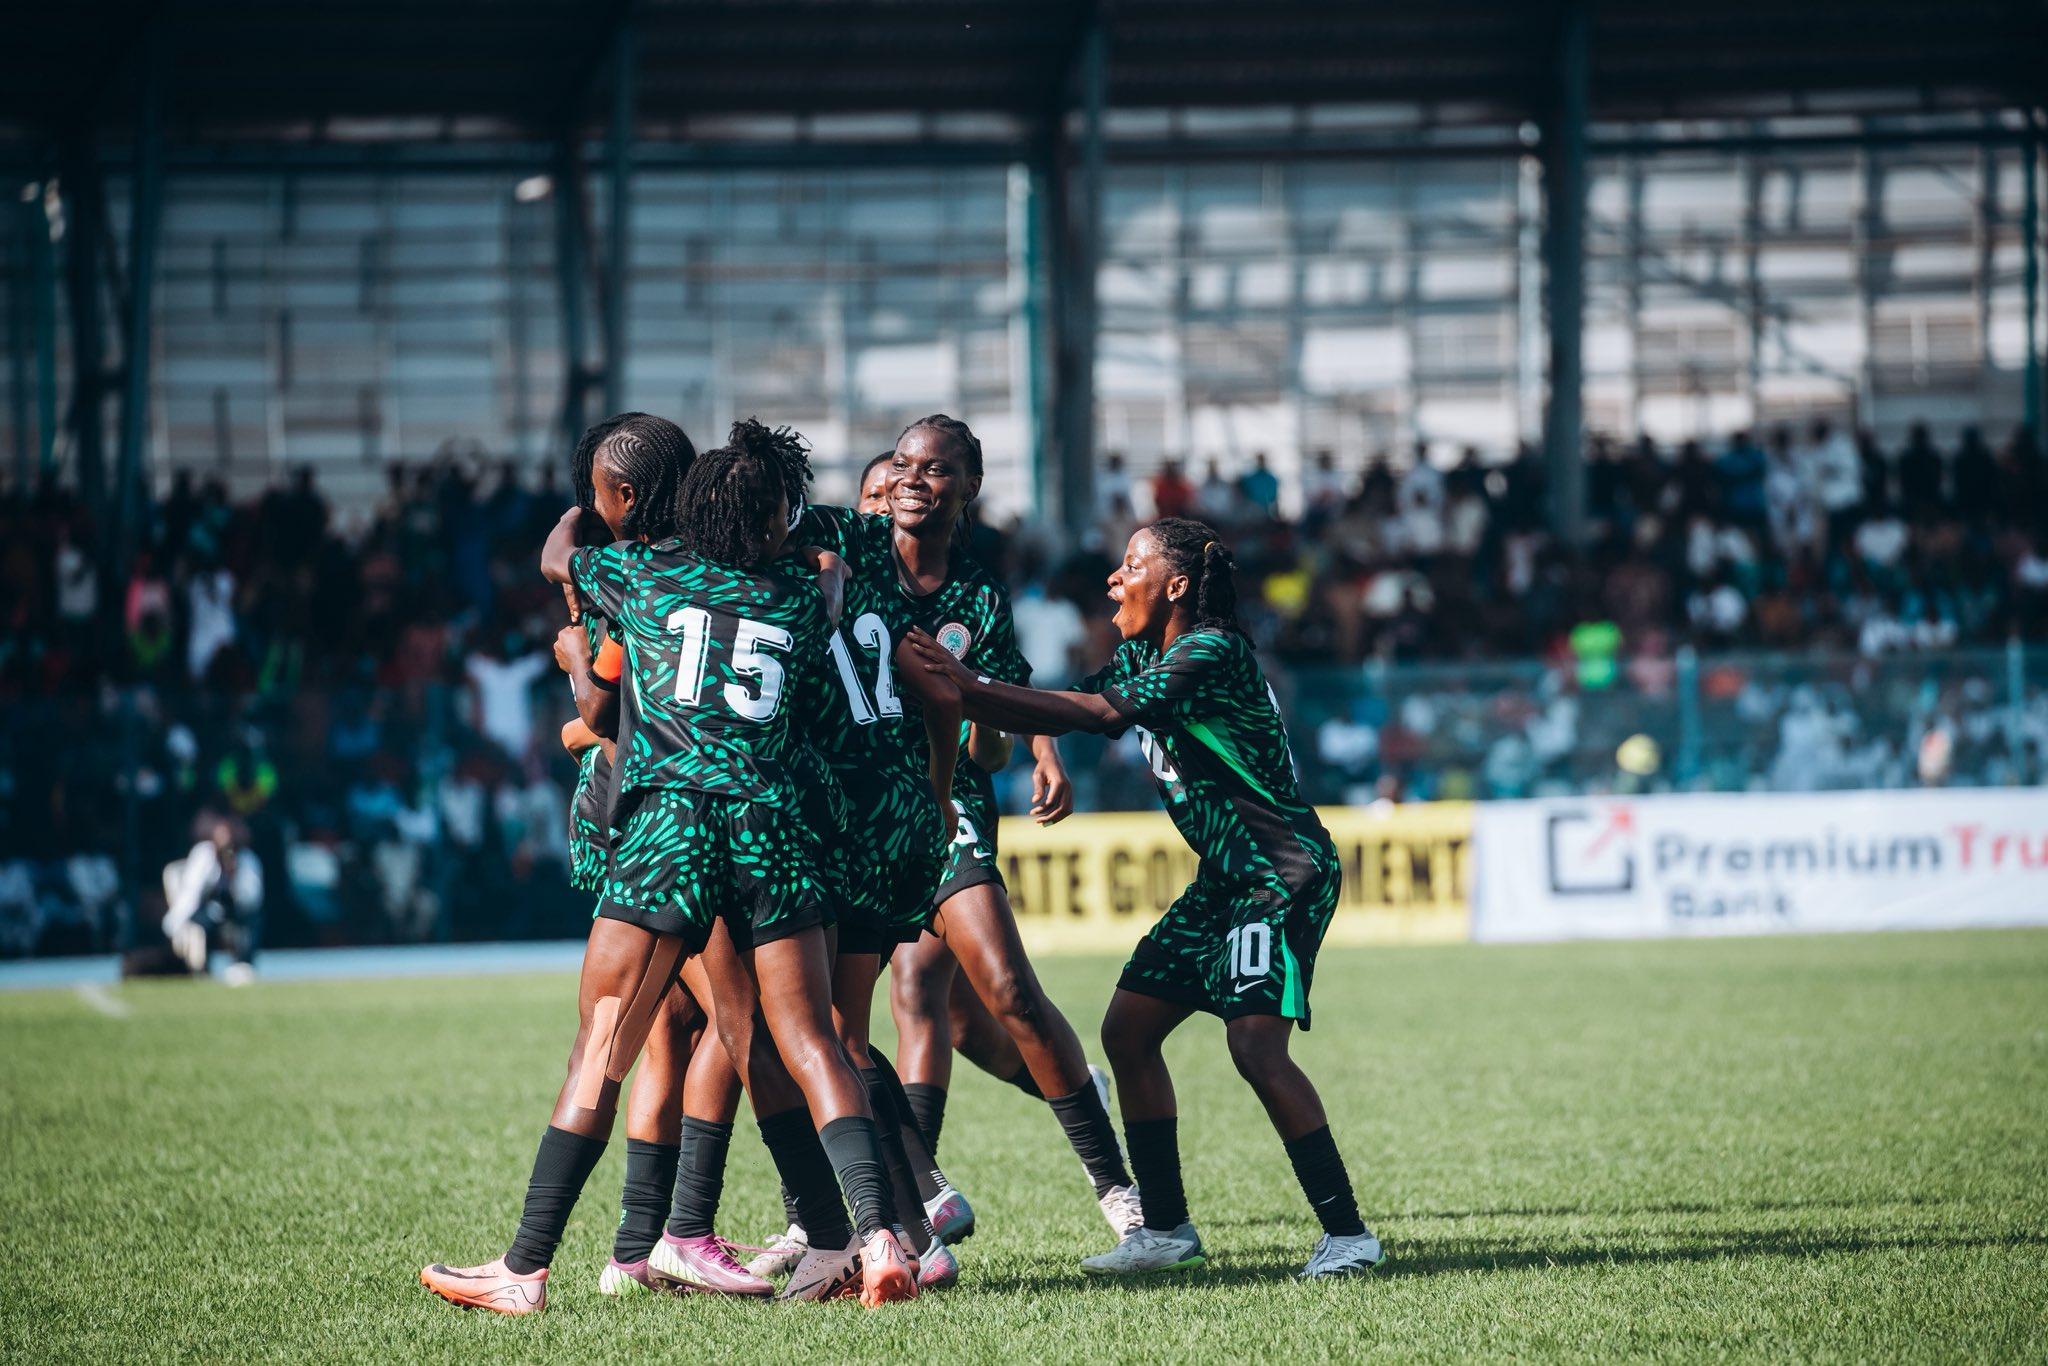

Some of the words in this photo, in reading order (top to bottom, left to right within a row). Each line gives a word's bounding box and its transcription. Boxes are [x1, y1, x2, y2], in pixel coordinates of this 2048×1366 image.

[667, 606, 794, 722] 15
[826, 612, 903, 725] 12
[1001, 848, 1087, 917] ATE
[1226, 922, 1271, 980] 10
